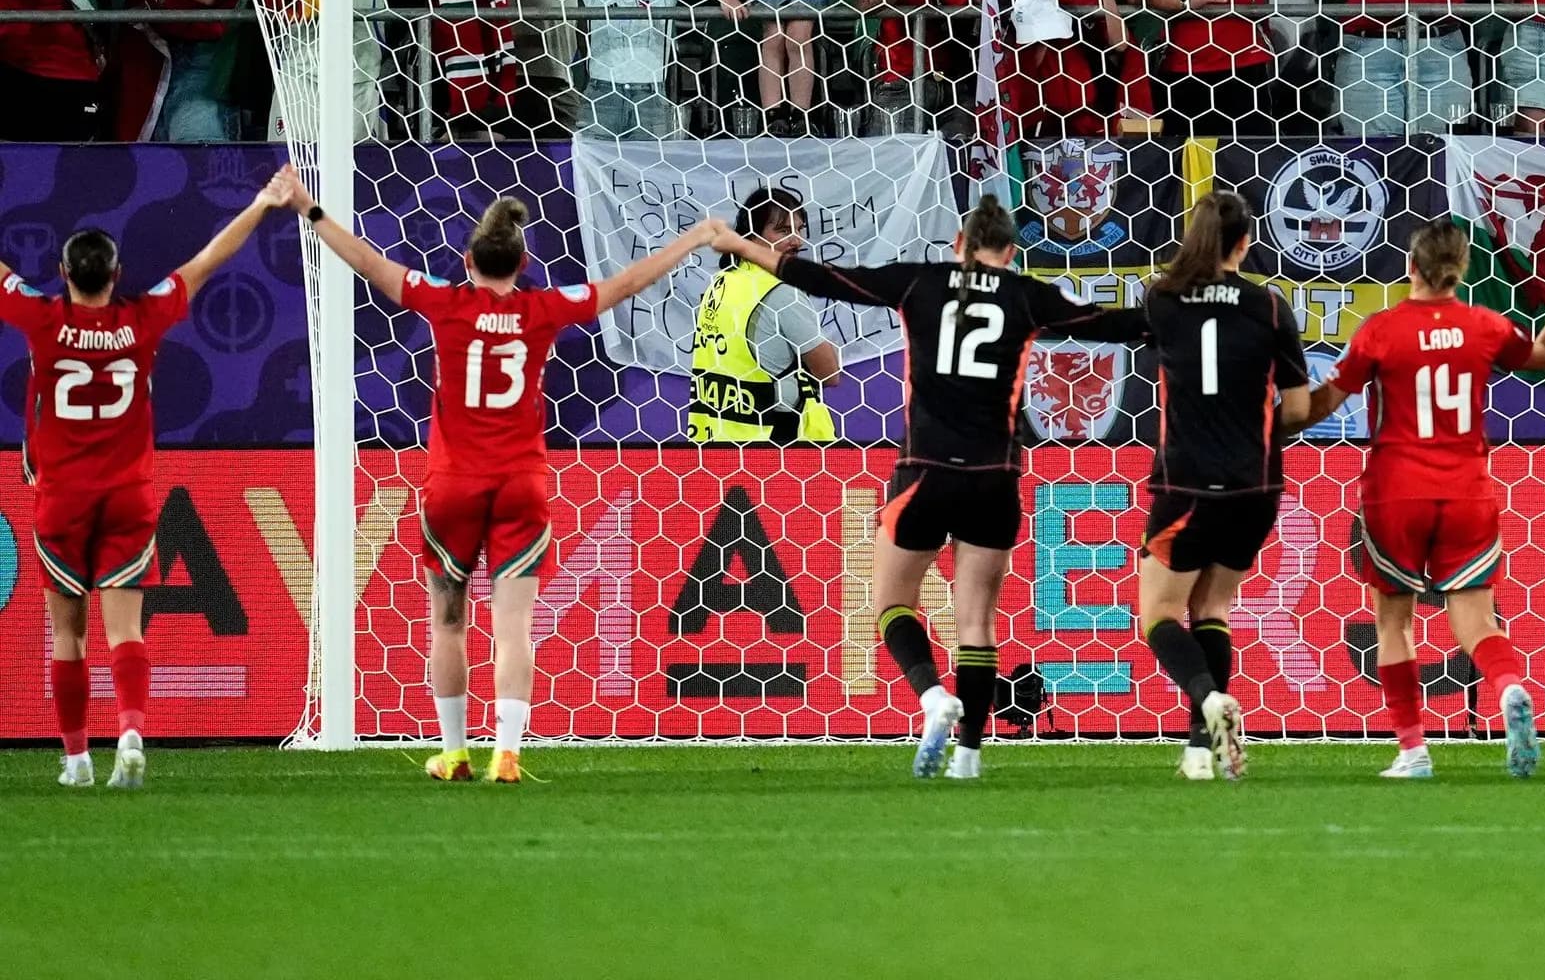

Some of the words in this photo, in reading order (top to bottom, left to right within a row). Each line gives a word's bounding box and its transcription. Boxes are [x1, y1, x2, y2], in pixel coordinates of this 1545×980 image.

[1309, 153, 1356, 171] SWANSEA
[1293, 246, 1318, 263] CITY
[475, 313, 523, 334] ROWE
[936, 300, 1005, 379] 12
[1418, 327, 1464, 351] LADD
[465, 339, 528, 409] 13
[1201, 318, 1218, 395] 1
[54, 358, 139, 420] 23
[1415, 363, 1472, 438] 14
